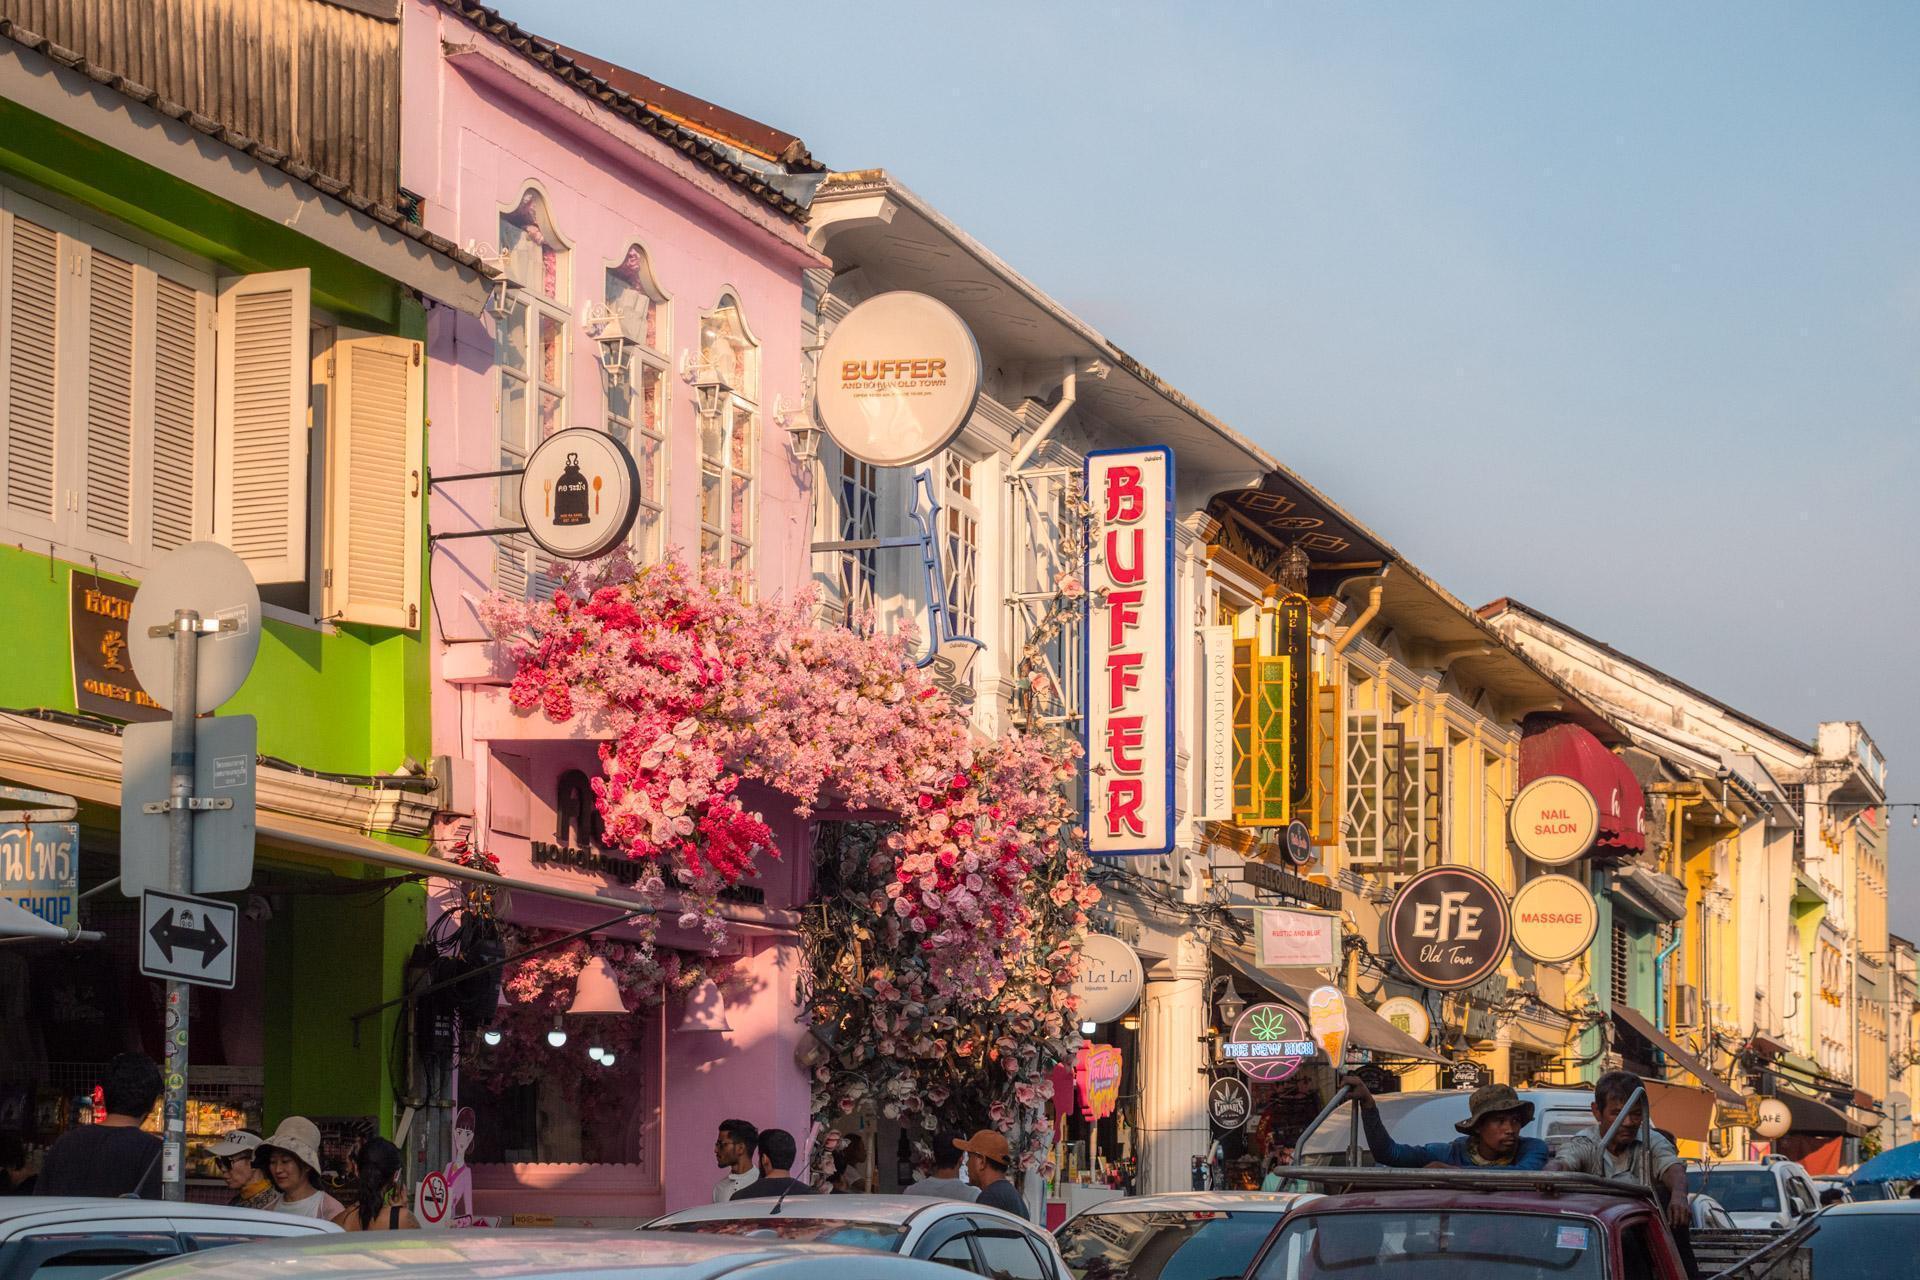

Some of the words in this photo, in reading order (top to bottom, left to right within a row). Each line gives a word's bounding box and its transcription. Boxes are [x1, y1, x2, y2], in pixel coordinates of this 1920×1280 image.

[841, 358, 947, 381] BUFFER
[897, 380, 917, 388] OLD
[919, 379, 947, 388] TOWN
[1104, 465, 1147, 837] BUFFER
[1541, 809, 1570, 820] NAIL
[1534, 823, 1577, 835] SALON
[1412, 890, 1484, 943] EFE
[1521, 912, 1583, 924] MASSAGE
[1293, 929, 1306, 937] AND
[1306, 929, 1321, 937] BLUE
[1420, 944, 1444, 963] Old
[1448, 945, 1475, 966] Town
[1088, 970, 1106, 983] La
[1110, 969, 1132, 983] La!
[1222, 1043, 1249, 1057] THE
[1251, 1042, 1282, 1057] NEW
[1284, 1041, 1314, 1056] HIGH
